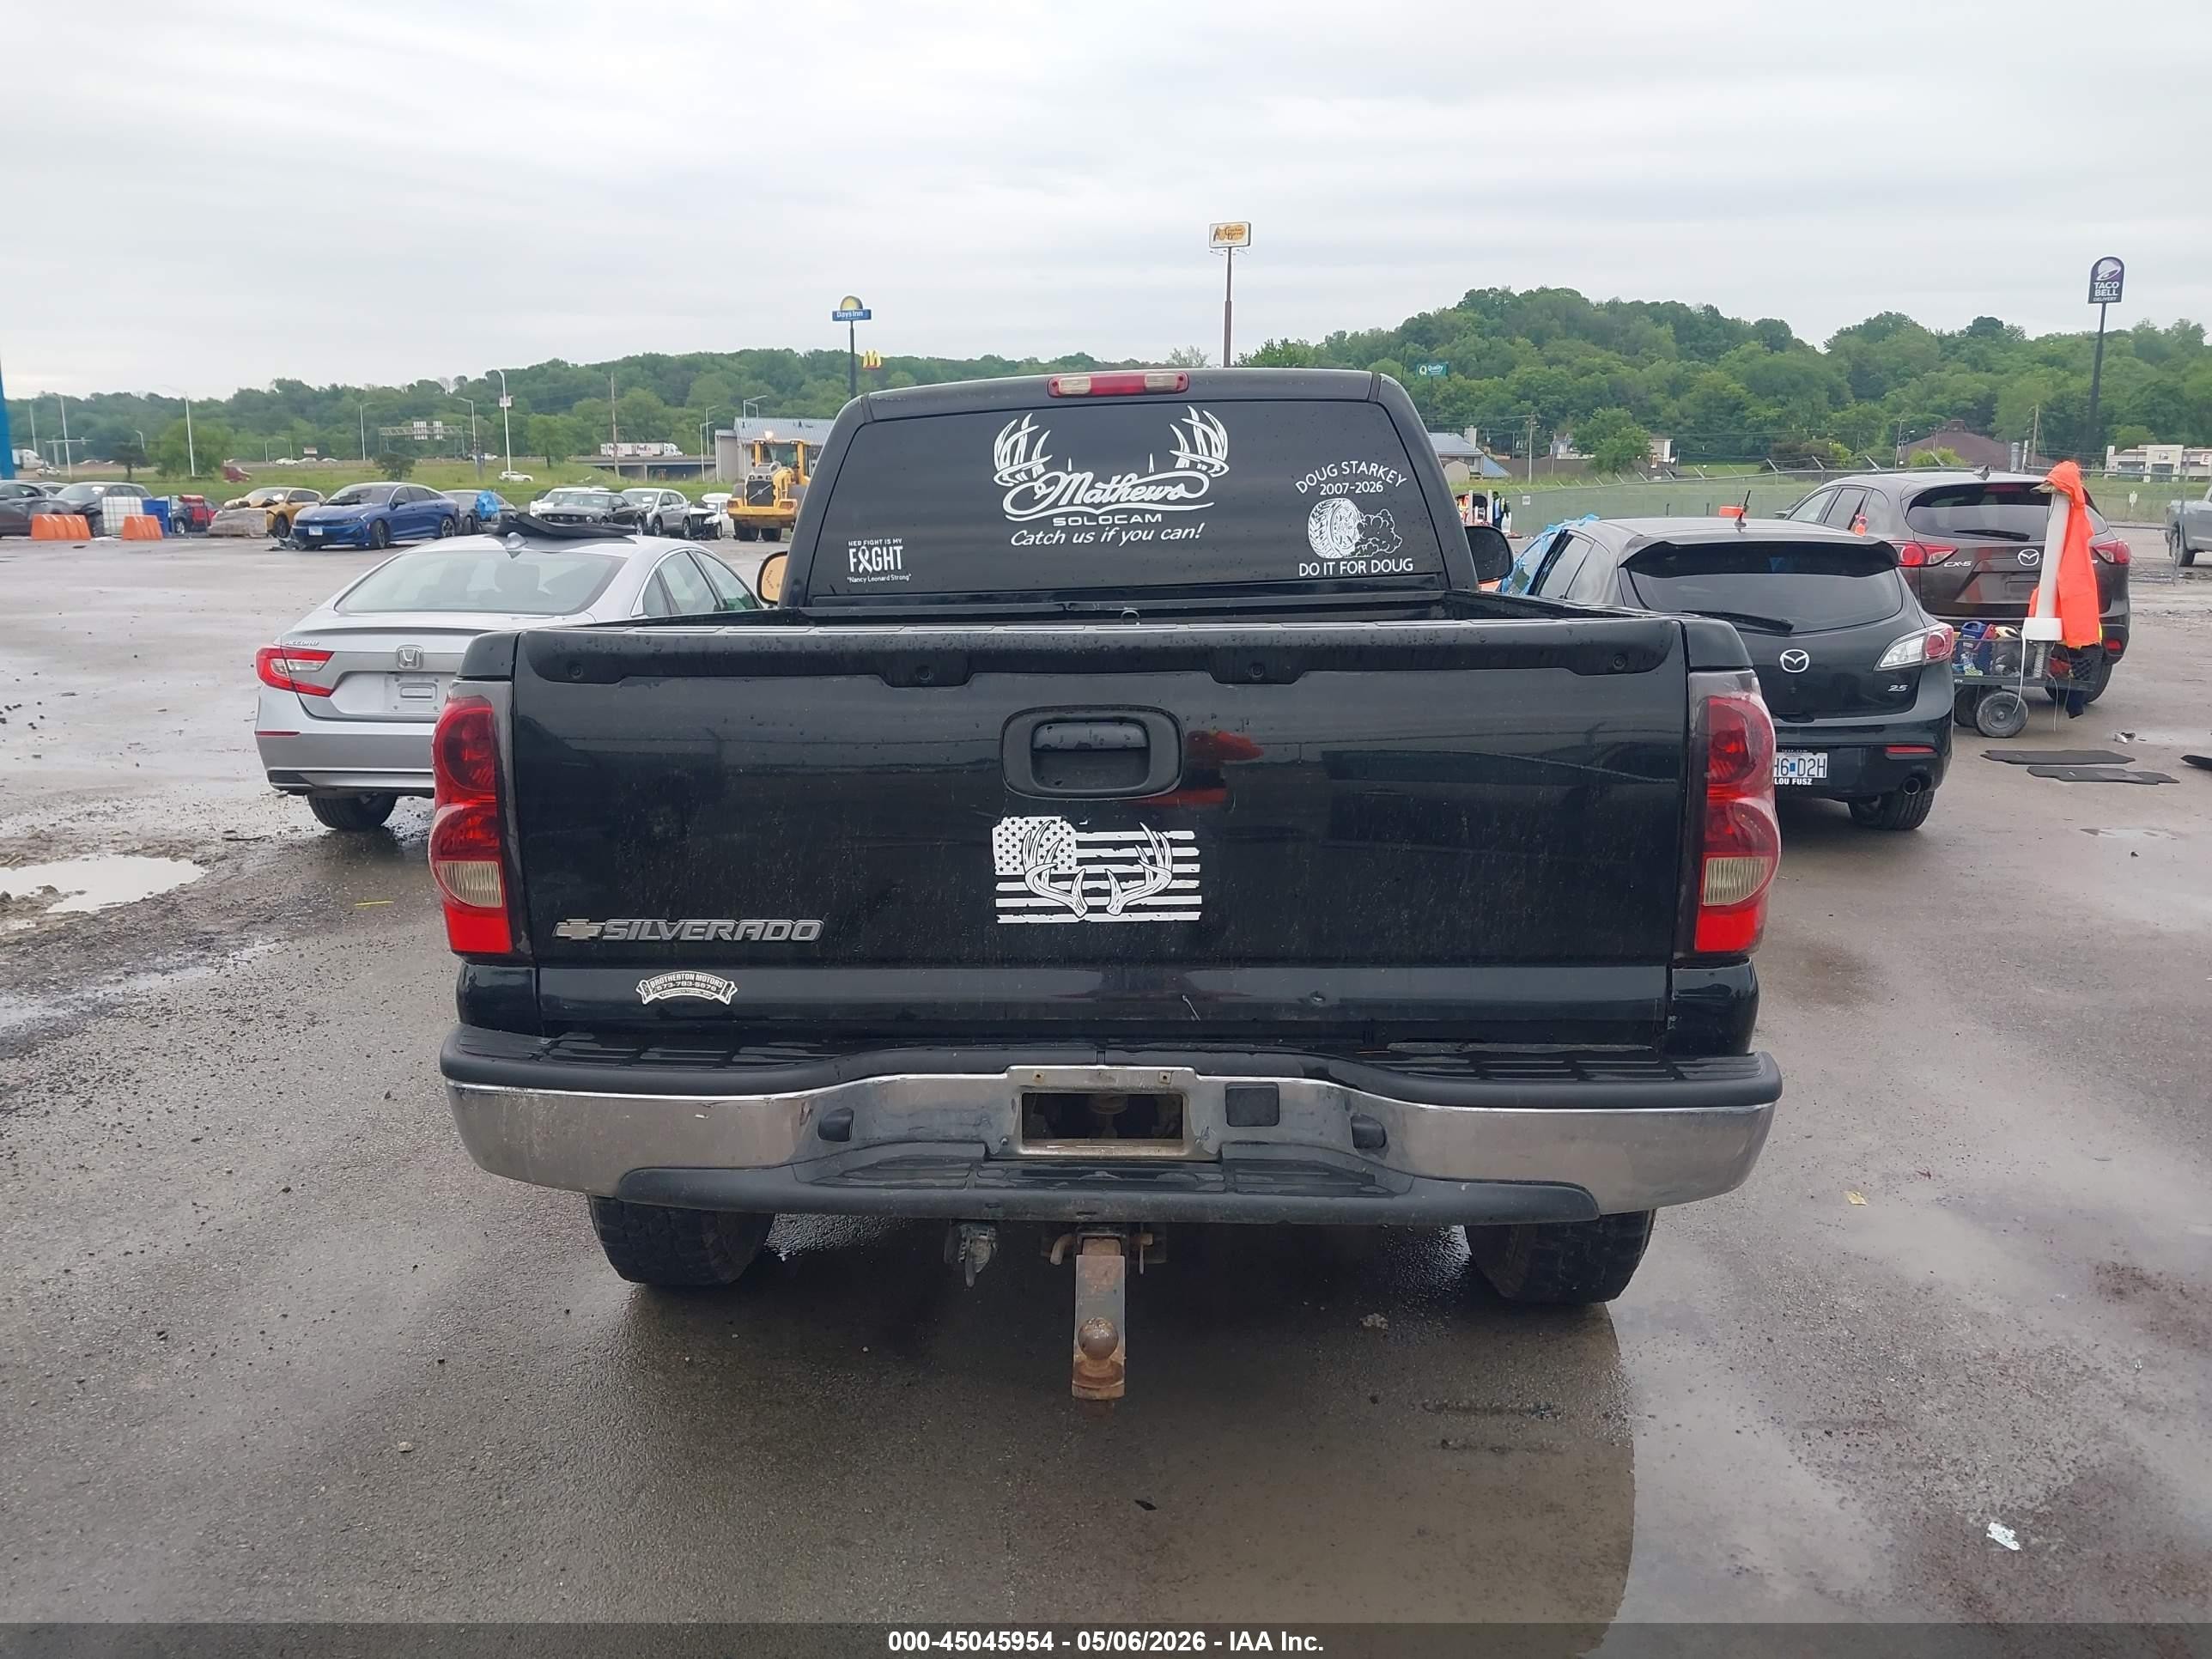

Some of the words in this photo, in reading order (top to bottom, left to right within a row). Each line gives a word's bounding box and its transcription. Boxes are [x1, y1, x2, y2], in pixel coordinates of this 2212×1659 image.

[2094, 281, 2120, 289] TACO
[2094, 289, 2118, 297] BELL
[1295, 464, 1338, 494] DOUG
[1341, 460, 1407, 488] STARKEY
[1003, 471, 1210, 515] Mathews
[1319, 481, 1384, 495] 2007-2026
[1052, 514, 1162, 527] SOLOCAM
[1010, 530, 1066, 546] Catch
[1073, 531, 1095, 544] us
[1100, 526, 1120, 544] if
[1117, 528, 1154, 547] you
[1160, 522, 1206, 542] can!
[1298, 562, 1320, 577] DO
[1323, 562, 1336, 575] IT
[1340, 560, 1367, 574] FOR
[1370, 557, 1413, 573] DOUG
[1797, 757, 1826, 777] D2H
[1791, 777, 1813, 786] FUSZ
[602, 919, 824, 941] SILVERADO
[650, 973, 696, 988] BROTHERTON
[695, 973, 725, 988] MOTORS
